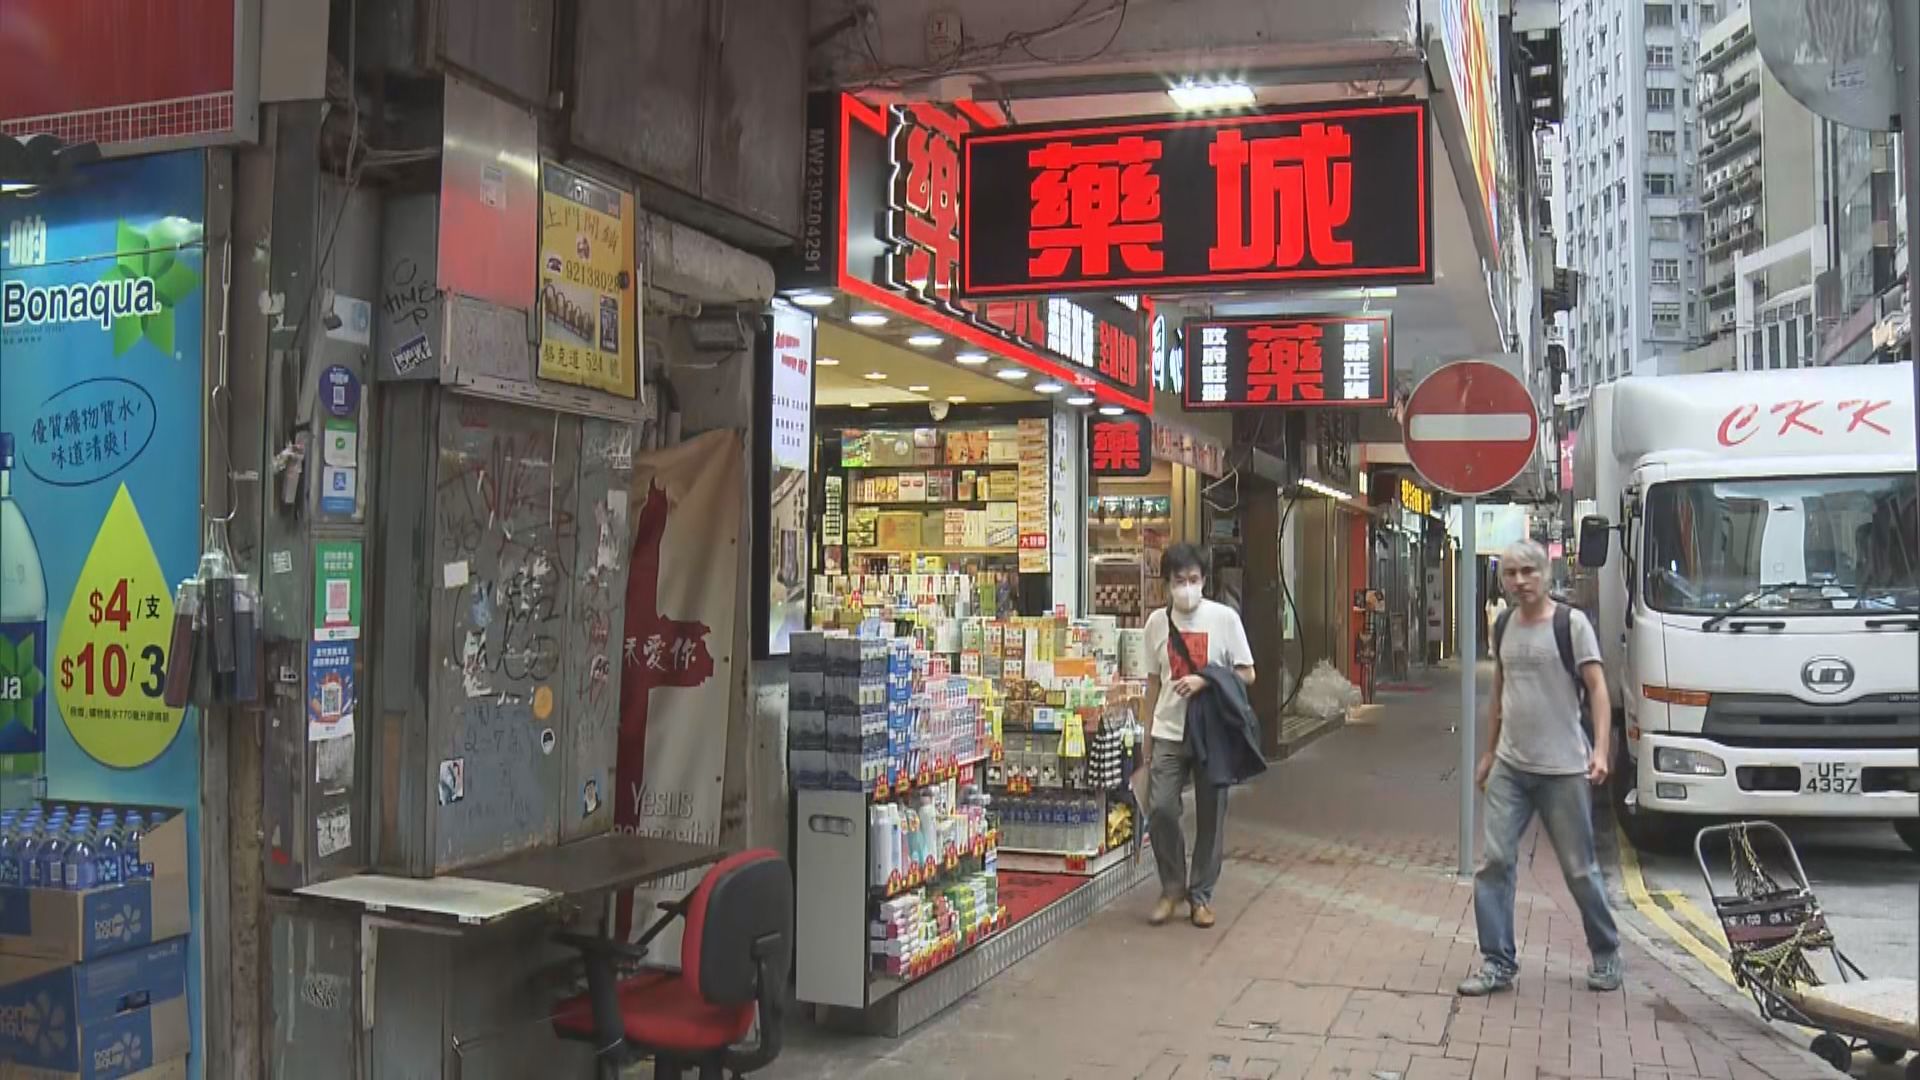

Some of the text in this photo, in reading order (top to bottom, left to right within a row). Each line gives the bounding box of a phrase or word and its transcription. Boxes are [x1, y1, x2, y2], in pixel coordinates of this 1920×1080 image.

[1028, 122, 1353, 278] 藥城
[3, 278, 157, 331] Bonaqua
[1247, 323, 1324, 402] 藥
[1092, 422, 1141, 470] 藥
[1806, 777, 1857, 793] 4337
[1818, 762, 1846, 777] UF
[632, 781, 694, 818] Yesus
